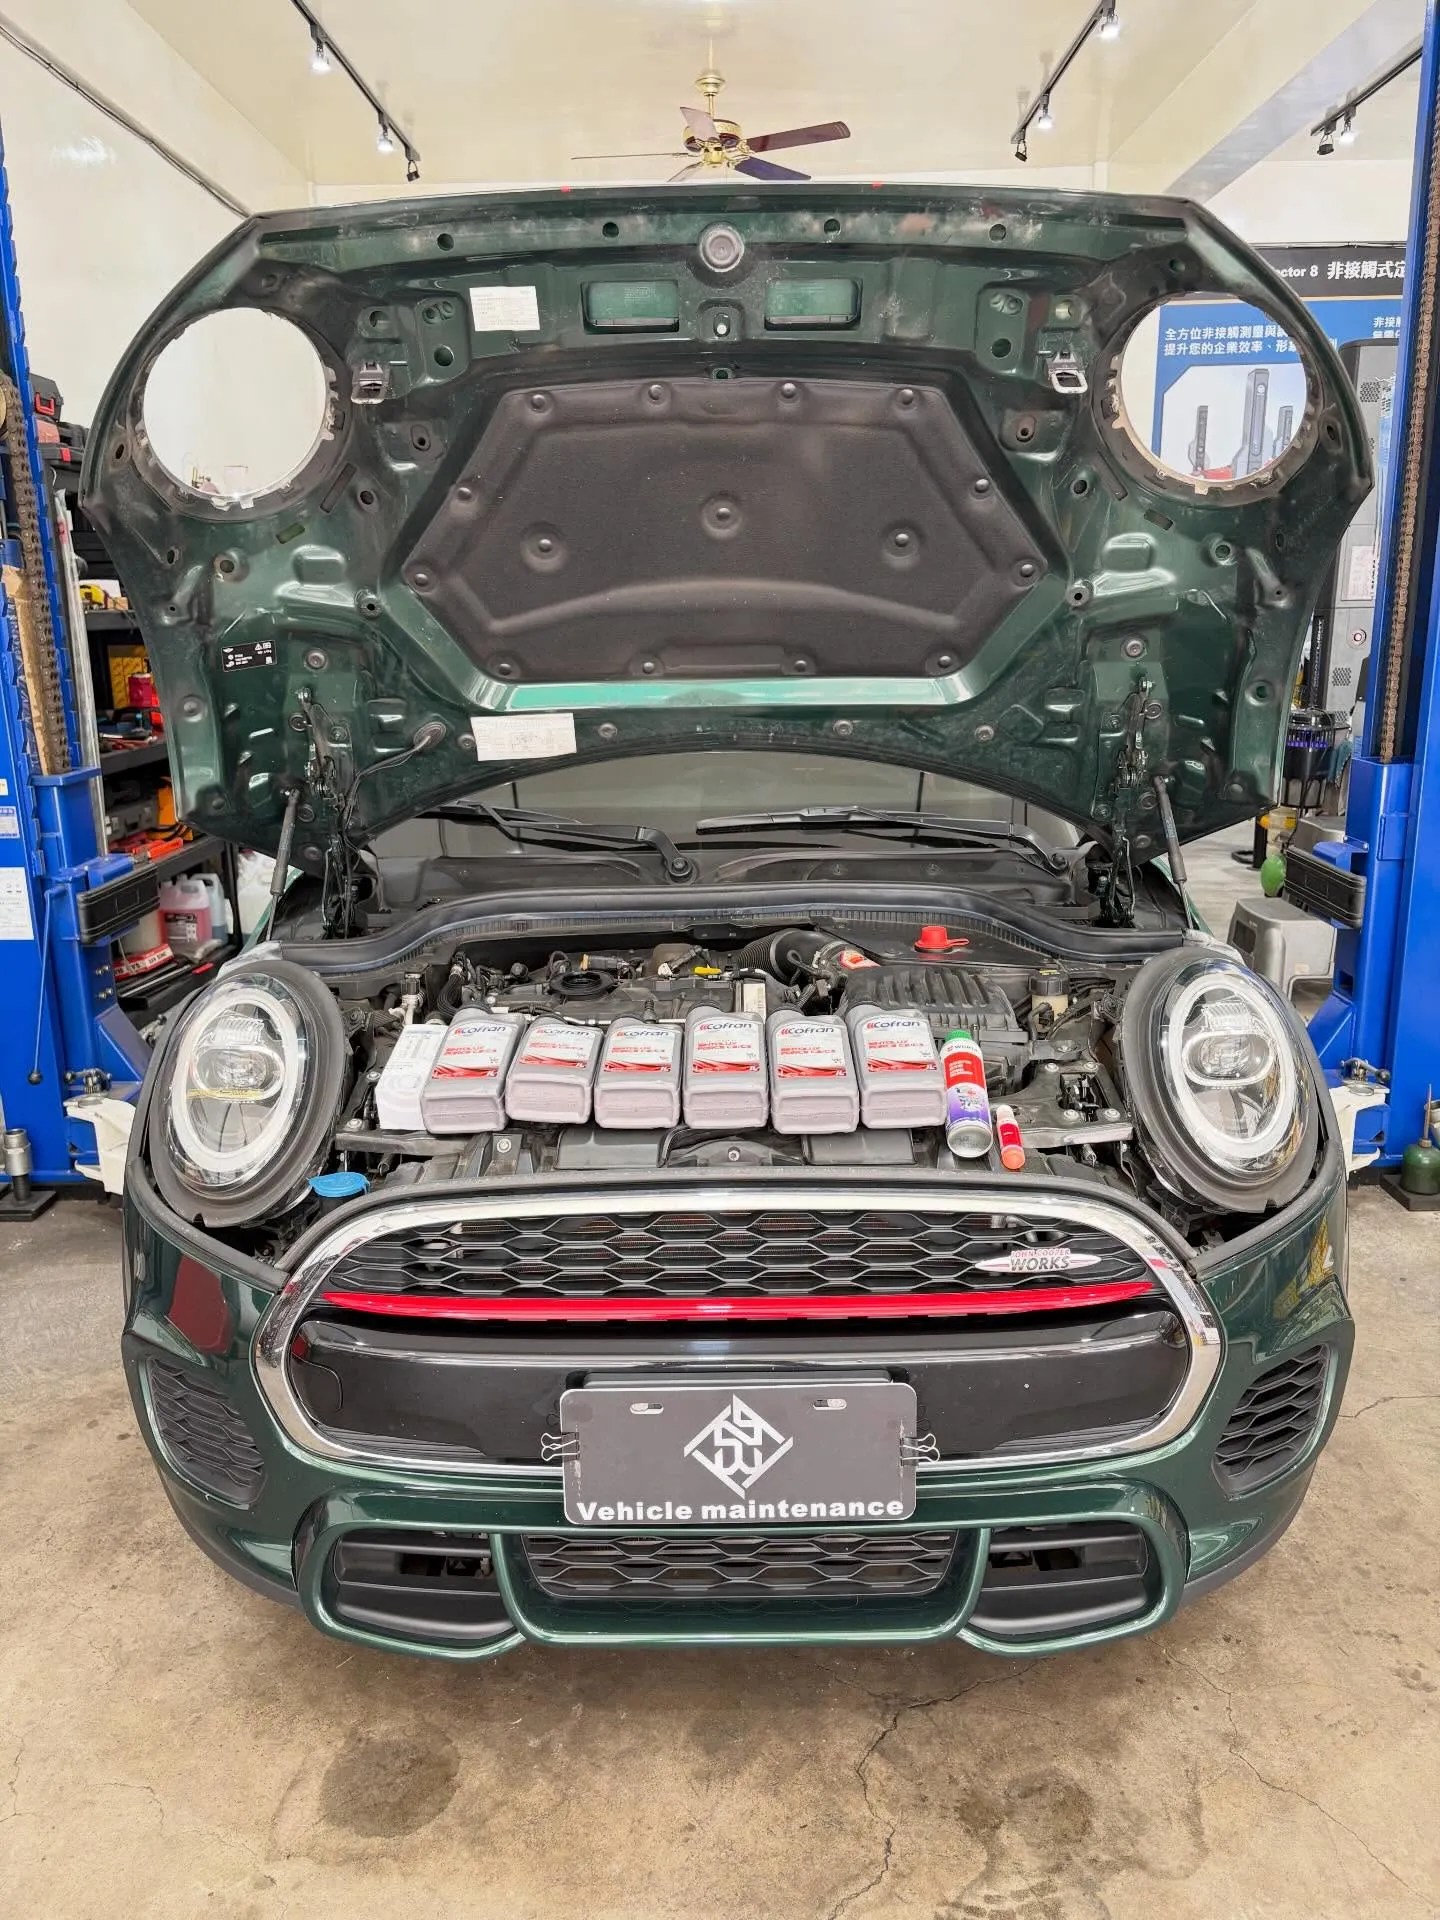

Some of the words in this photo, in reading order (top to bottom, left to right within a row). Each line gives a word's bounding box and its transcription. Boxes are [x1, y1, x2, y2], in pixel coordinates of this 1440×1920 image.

[1275, 266, 1307, 278] ctor
[1310, 264, 1319, 278] 8
[1037, 1248, 1070, 1256] COOPER
[1010, 1256, 1070, 1271] WORKS
[576, 1501, 693, 1521] Vehicle
[701, 1499, 904, 1520] maintenance
